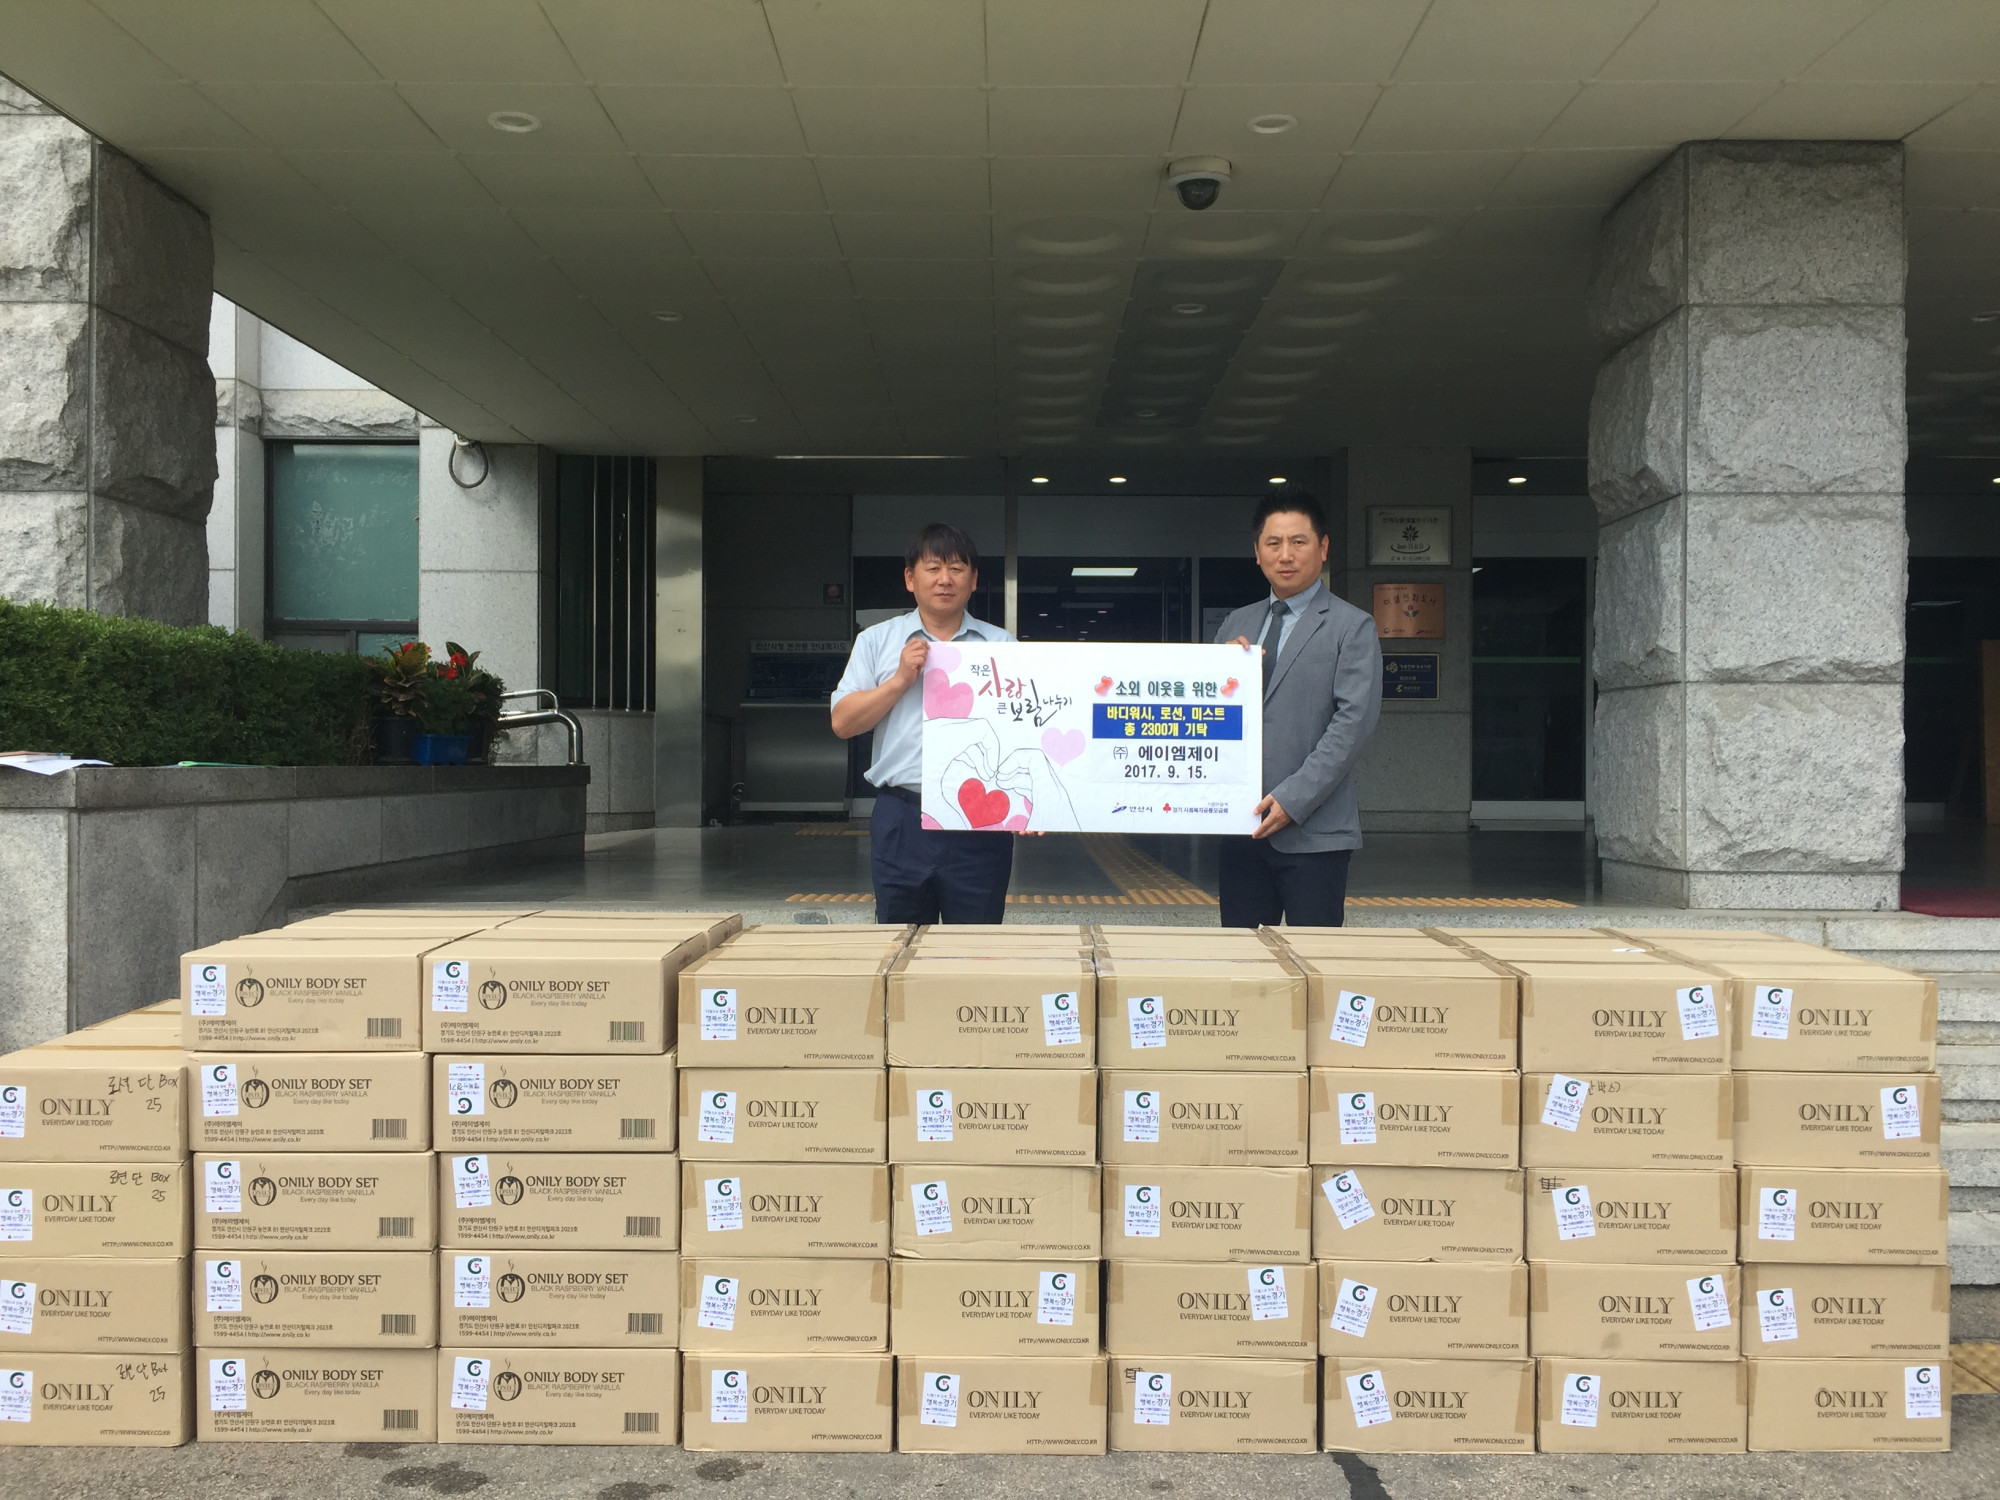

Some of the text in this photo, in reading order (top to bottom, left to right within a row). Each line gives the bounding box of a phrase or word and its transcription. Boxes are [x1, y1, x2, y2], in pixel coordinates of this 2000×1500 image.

[970, 656, 1027, 699] 작은 사랑
[1115, 681, 1217, 697] 소외 이웃을 위한
[997, 702, 1007, 714] 큰
[1042, 694, 1073, 711] 나누기
[1106, 706, 1226, 721] 바디워시, 로션, 미스트
[1124, 722, 1208, 737] 총 2300개 기탁
[1138, 745, 1219, 762] 에이엠제이
[1124, 765, 1207, 779] 2017. 9. 15.
[266, 978, 367, 989] ONILY BODY SET
[509, 981, 610, 992] ONILY BODY SET
[745, 1007, 819, 1024] ONILY
[956, 1006, 1029, 1023] ONILY
[1166, 1009, 1239, 1026] ONILY
[1375, 1006, 1449, 1023] ONILY
[1592, 1010, 1667, 1027] ONILY
[1798, 1009, 1872, 1026] ONILY
[159, 1073, 179, 1088] Box
[271, 1079, 372, 1090] ONILY BODY SET
[520, 1079, 620, 1090] ONILY BODY SET
[40, 1099, 114, 1115] ONILY
[145, 1097, 162, 1112] 25
[746, 1100, 819, 1118] ONILY
[956, 1102, 1030, 1120] ONILY
[1169, 1102, 1243, 1120] ONILY
[1378, 1104, 1453, 1122] ONILY
[1799, 1104, 1873, 1122] ONILY
[1591, 1107, 1666, 1124] ONILY
[151, 1172, 171, 1183] Box
[278, 1177, 379, 1188] ONILY BODY SET
[526, 1176, 626, 1187] ONILY BODY SET
[43, 1195, 117, 1212] ONILY
[151, 1189, 166, 1202] 25
[749, 1195, 822, 1212] ONILY
[962, 1197, 1035, 1214] ONILY
[1170, 1201, 1244, 1219] ONILY
[1381, 1198, 1456, 1216] ONILY
[1596, 1201, 1672, 1219] ONILY
[1809, 1201, 1883, 1220] ONILY
[280, 1275, 381, 1286] ONILY BODY SET
[527, 1274, 628, 1285] ONILY BODY SET
[39, 1289, 112, 1307] ONILY
[748, 1289, 821, 1306] ONILY
[959, 1290, 1034, 1307] ONILY
[1177, 1292, 1250, 1310] ONILY
[1387, 1295, 1462, 1313] ONILY
[1599, 1296, 1674, 1314] ONILY
[1812, 1297, 1886, 1314] ONILY
[1848, 1318, 1861, 1326] LIKE
[1862, 1318, 1885, 1326] TODAY
[282, 1370, 383, 1381] ONILY BODY SET
[524, 1372, 625, 1383] ONILY BODY SET
[41, 1383, 114, 1400] ONILY
[149, 1386, 166, 1402] 25
[752, 1387, 826, 1403] ONILY
[967, 1391, 1041, 1408] ONILY
[1178, 1390, 1252, 1408] ONILY
[1394, 1391, 1468, 1408] ONILY
[1609, 1391, 1682, 1408] ONILY
[1815, 1390, 1888, 1408] ONILY
[1004, 1412, 1017, 1420] LIKE
[1018, 1412, 1040, 1420] TODAY
